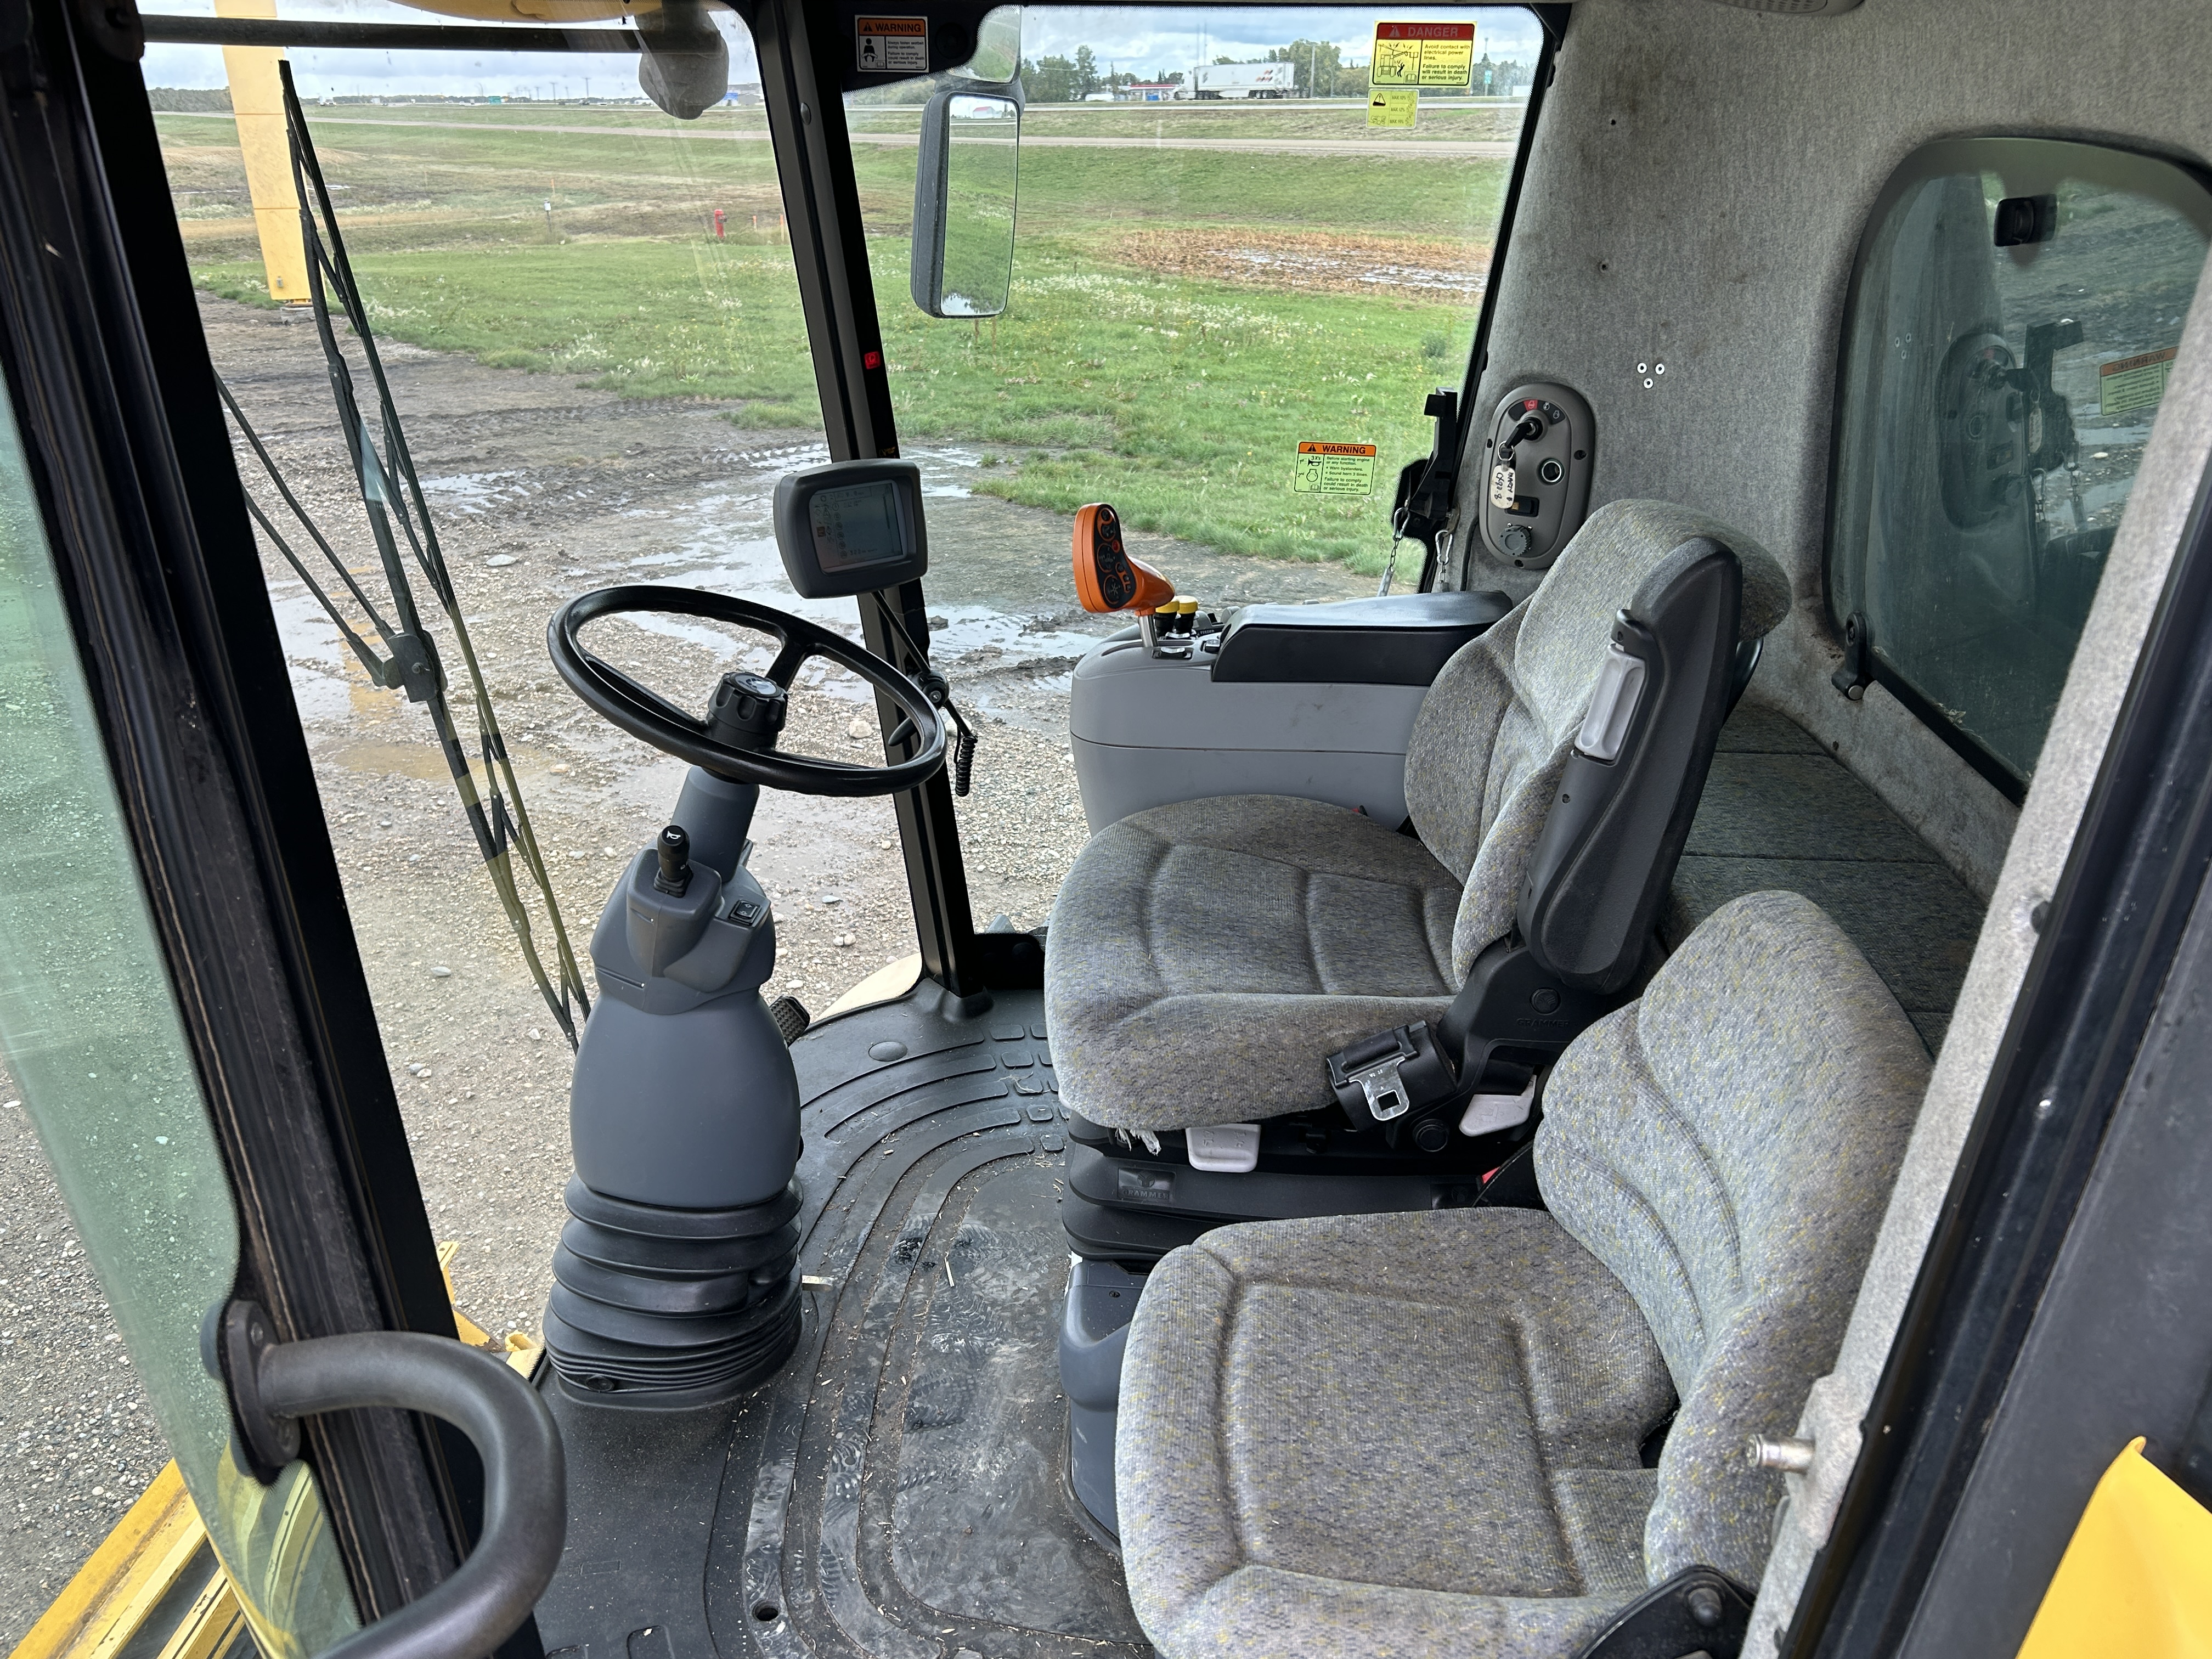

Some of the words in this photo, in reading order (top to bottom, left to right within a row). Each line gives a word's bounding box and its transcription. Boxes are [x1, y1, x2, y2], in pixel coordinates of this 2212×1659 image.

[876, 23, 921, 32] WARNING
[1408, 26, 1458, 37] DANGER
[1322, 445, 1366, 454] WARNING
[1516, 1018, 1569, 1027] GRAMMER
[1123, 1188, 1170, 1199] GRAMMER
